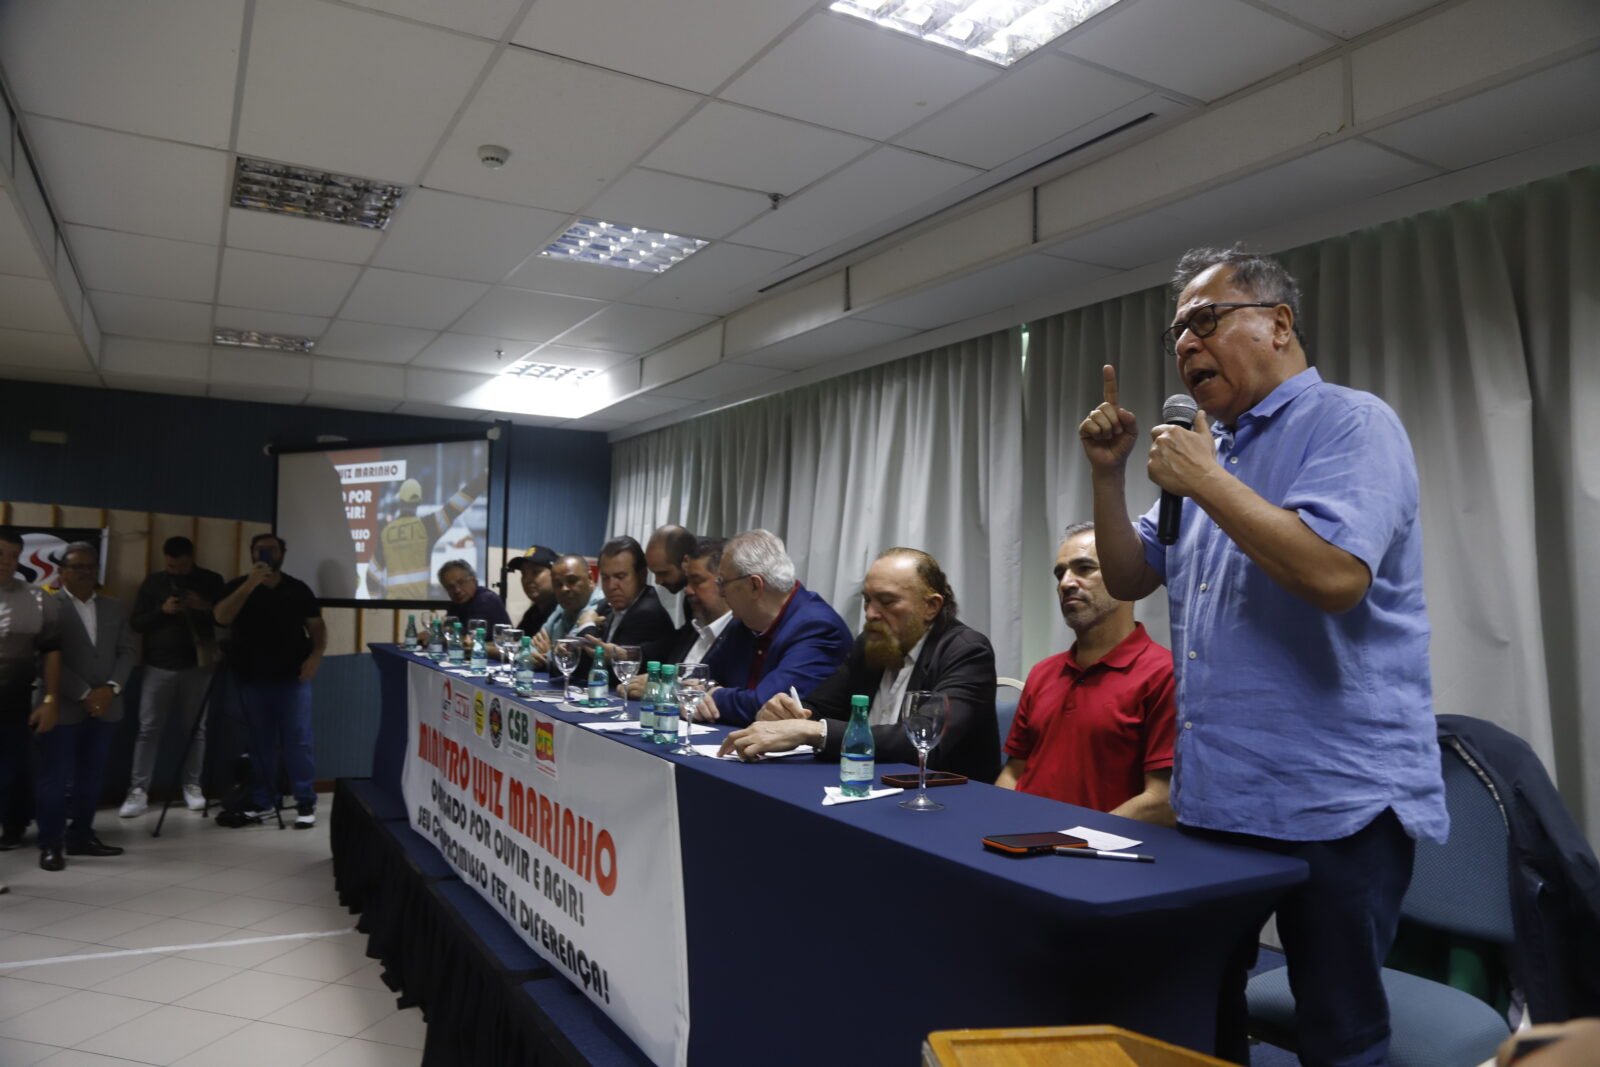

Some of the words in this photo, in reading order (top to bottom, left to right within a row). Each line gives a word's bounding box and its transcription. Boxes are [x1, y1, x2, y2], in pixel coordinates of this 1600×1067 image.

[348, 489, 373, 503] POR
[354, 464, 398, 478] MARINHO
[508, 706, 529, 746] CSB
[472, 756, 504, 819] LUIZ
[508, 776, 618, 897] MARINHO
[417, 805, 432, 833] SEU
[509, 890, 516, 921] A
[519, 898, 610, 1005] DIFERENÇA!
[469, 809, 492, 849] POR
[493, 829, 530, 884] OUVIR
[533, 858, 540, 891] E
[543, 865, 585, 927] AGIR!
